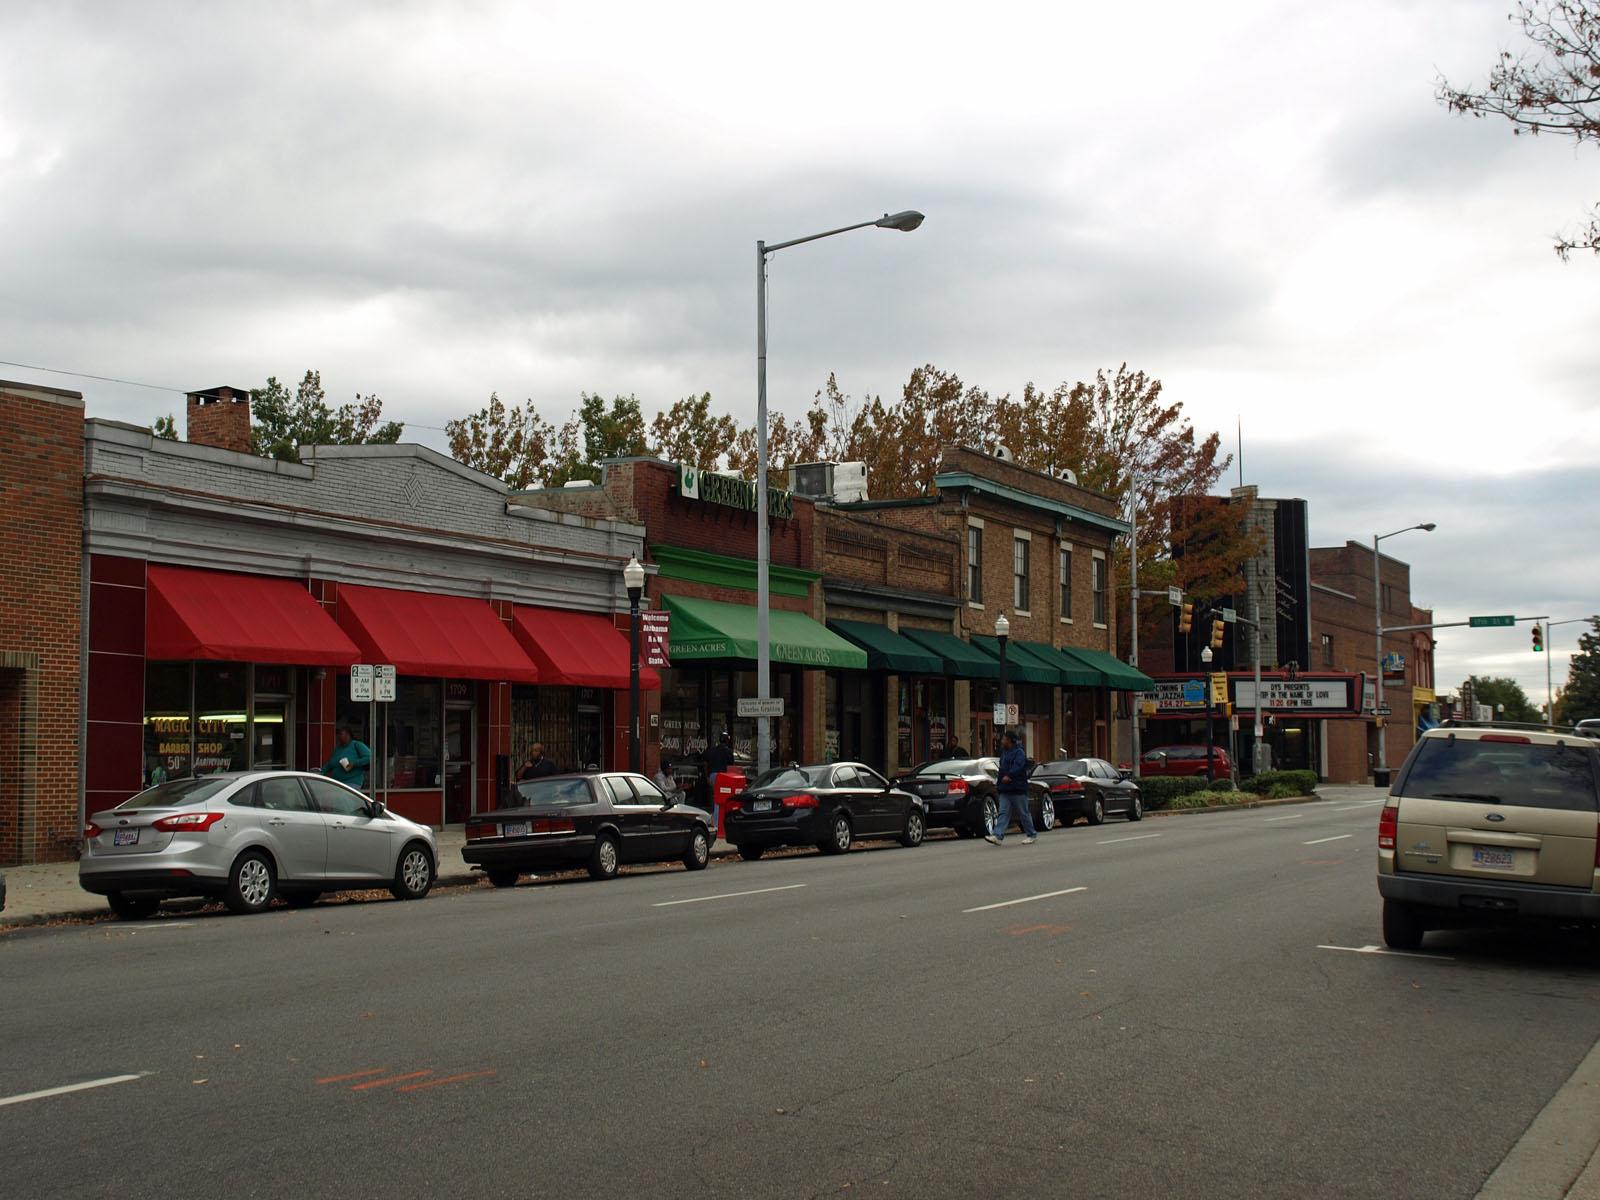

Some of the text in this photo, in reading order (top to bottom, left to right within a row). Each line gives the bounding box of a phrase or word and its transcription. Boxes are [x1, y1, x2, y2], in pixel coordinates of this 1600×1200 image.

[700, 471, 793, 520] GREEN ARES
[670, 643, 726, 653] GREEN ACRES
[776, 643, 830, 664] GREEN ACRES
[1144, 692, 1185, 700] WWW.JAZZHA
[155, 718, 229, 734] MAGIC CITY
[663, 720, 682, 729] GREEN
[159, 743, 223, 754] BARBER SHOP
